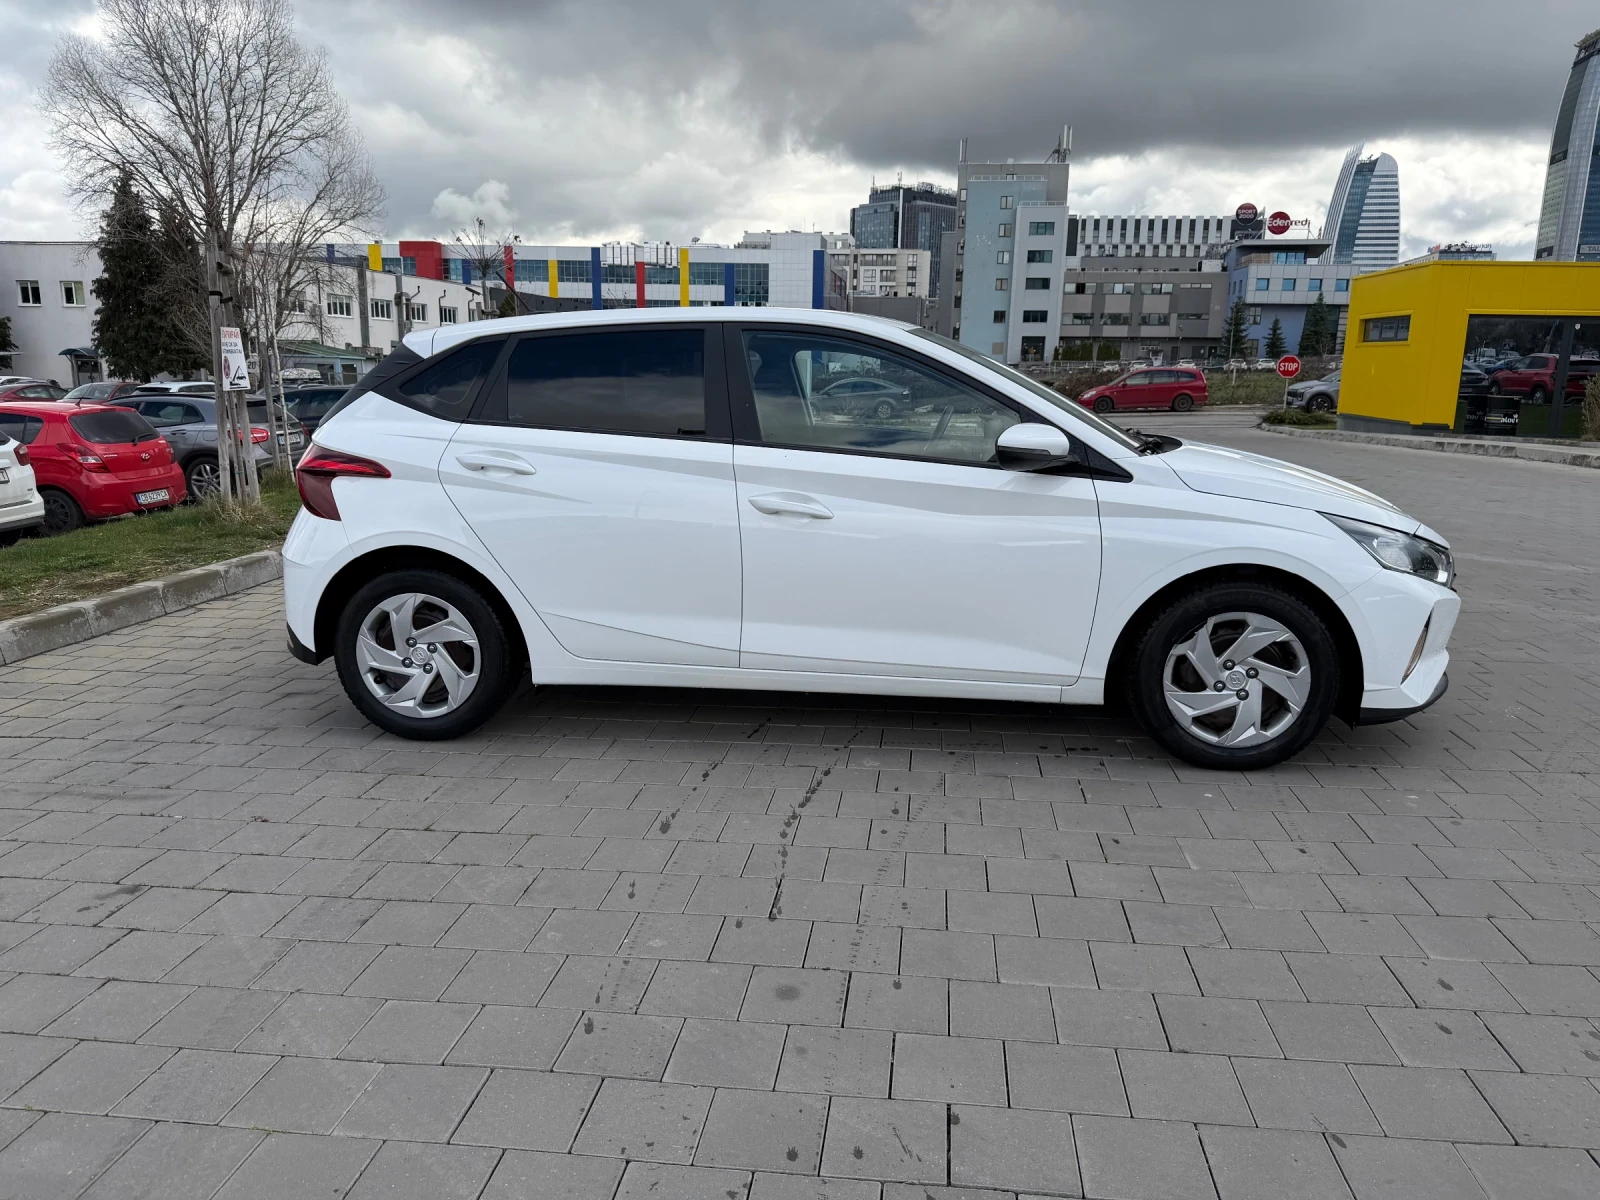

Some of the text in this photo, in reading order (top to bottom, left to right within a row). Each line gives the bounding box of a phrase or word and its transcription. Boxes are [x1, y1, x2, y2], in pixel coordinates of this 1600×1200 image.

[1267, 218, 1308, 226] Edenred
[247, 361, 257, 370] 20
[1280, 362, 1299, 371] STOP
